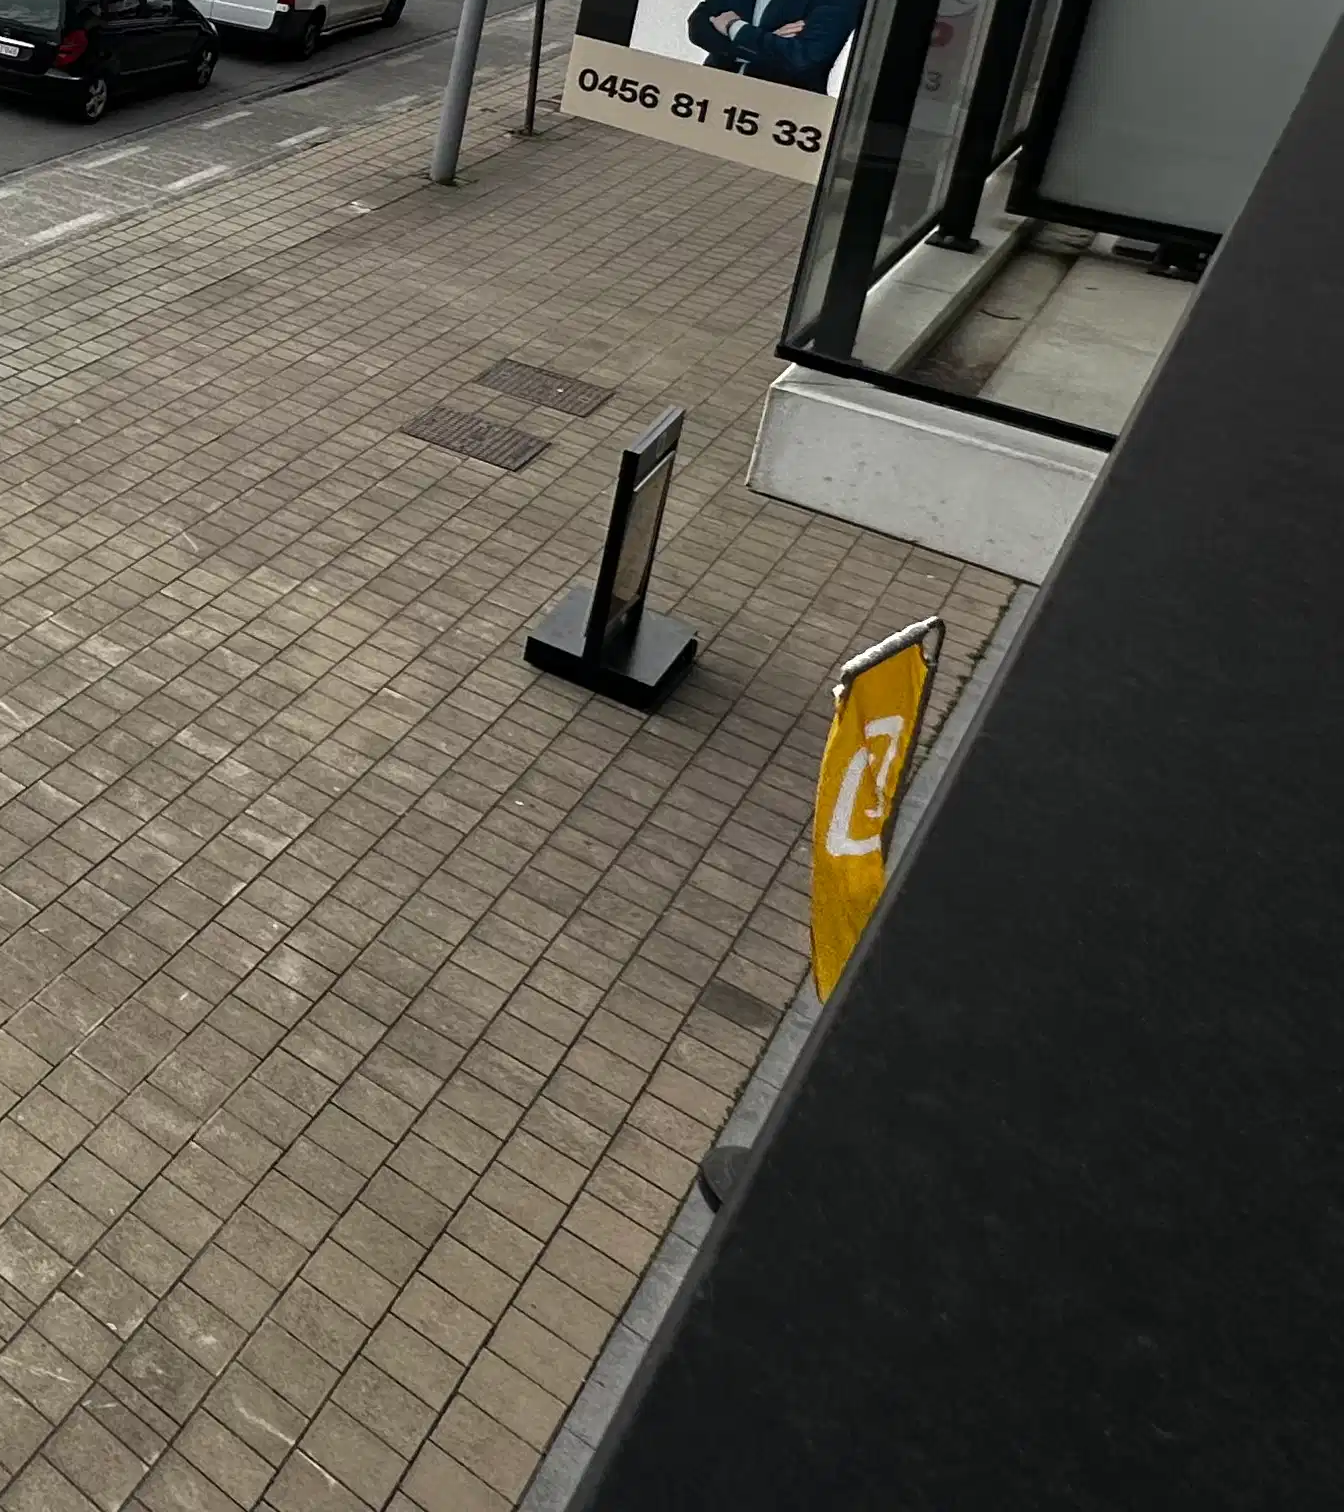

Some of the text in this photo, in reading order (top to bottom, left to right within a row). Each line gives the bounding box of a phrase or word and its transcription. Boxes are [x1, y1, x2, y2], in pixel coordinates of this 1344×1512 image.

[578, 68, 823, 154] 0456 81 15 33
